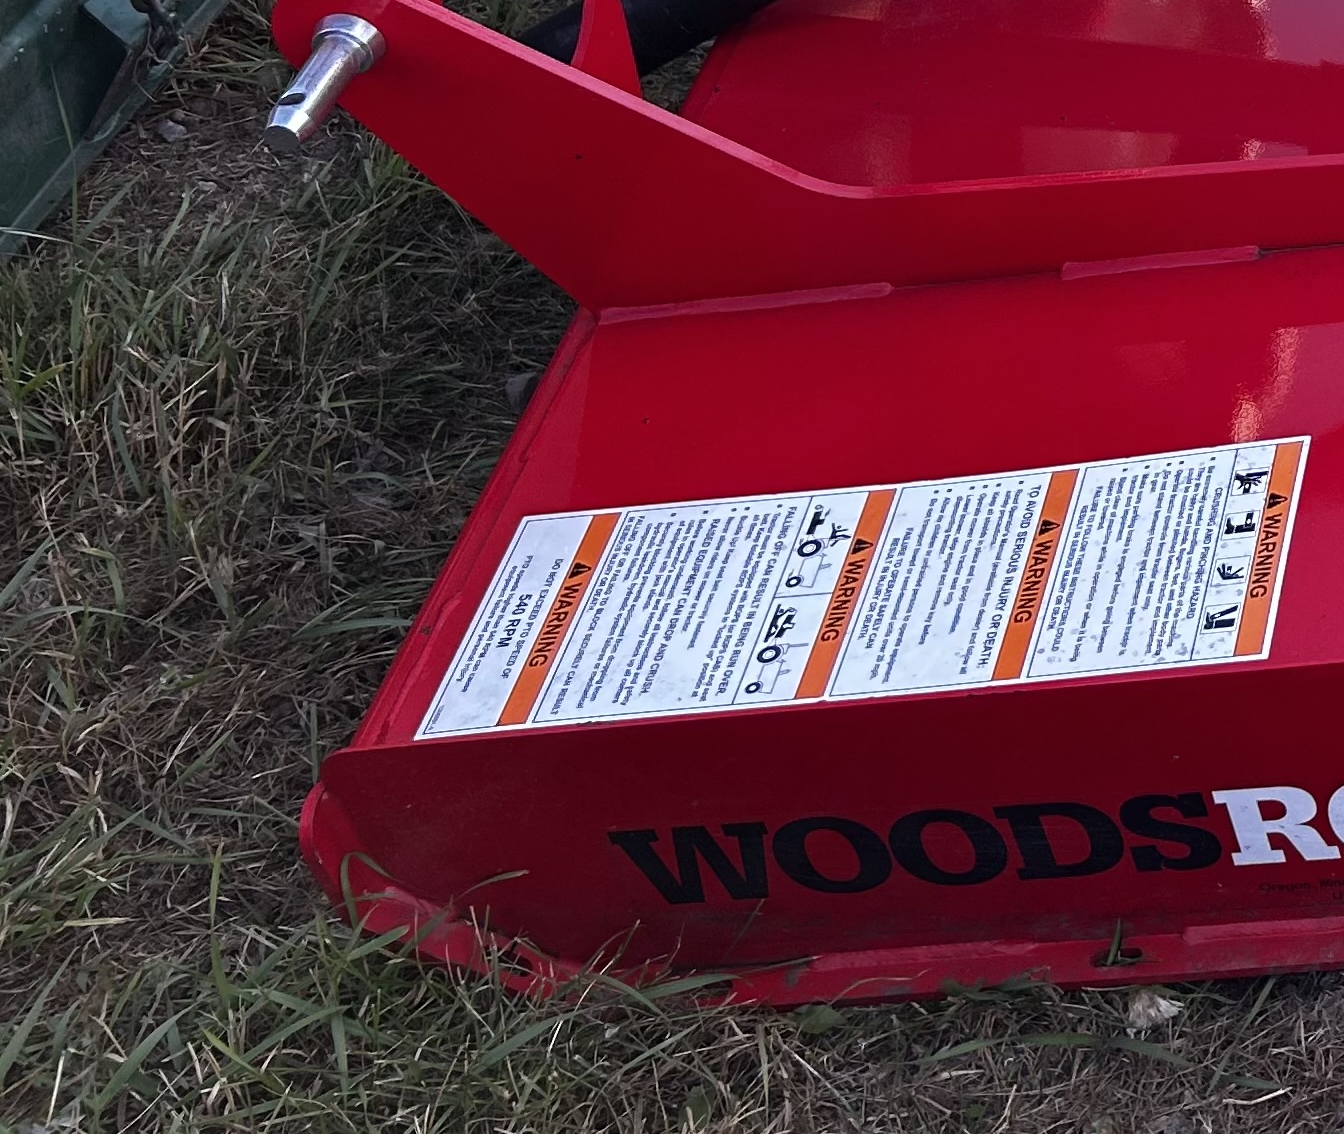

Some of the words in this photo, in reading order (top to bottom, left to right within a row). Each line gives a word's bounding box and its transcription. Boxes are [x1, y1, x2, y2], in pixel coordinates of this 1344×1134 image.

[1026, 484, 1041, 498] TO
[775, 505, 797, 539] FALLING
[1017, 499, 1037, 529] AVOID
[699, 518, 721, 548] RAISED
[895, 527, 914, 557] FAILURE
[768, 540, 784, 557] OFF
[1003, 530, 1028, 574] SERIOUS
[1247, 512, 1282, 599] WARNING
[549, 558, 564, 570] DO
[678, 548, 708, 596] EQUIPMENT
[761, 557, 777, 576] CAN
[540, 571, 558, 587] NOT
[748, 576, 770, 609] RESULT
[879, 569, 900, 602] OPERATE
[992, 575, 1015, 611] INJURY
[1012, 539, 1053, 623] WARNING
[509, 592, 534, 616] 540
[525, 588, 549, 621] EXCEED
[670, 597, 688, 616] CAN
[818, 559, 866, 642] WARNING
[526, 582, 583, 667] WARNING
[744, 610, 757, 620] IN
[869, 603, 888, 631] SAFELY
[987, 613, 1004, 629] OR
[493, 618, 522, 649] RPM
[516, 621, 534, 638] PTO
[659, 617, 680, 642] DROP
[733, 620, 753, 648] BEING
[863, 632, 878, 649] CAN
[503, 639, 526, 667] SPEED
[651, 642, 669, 662] AND
[725, 648, 742, 668] RUN
[497, 667, 512, 679] OF
